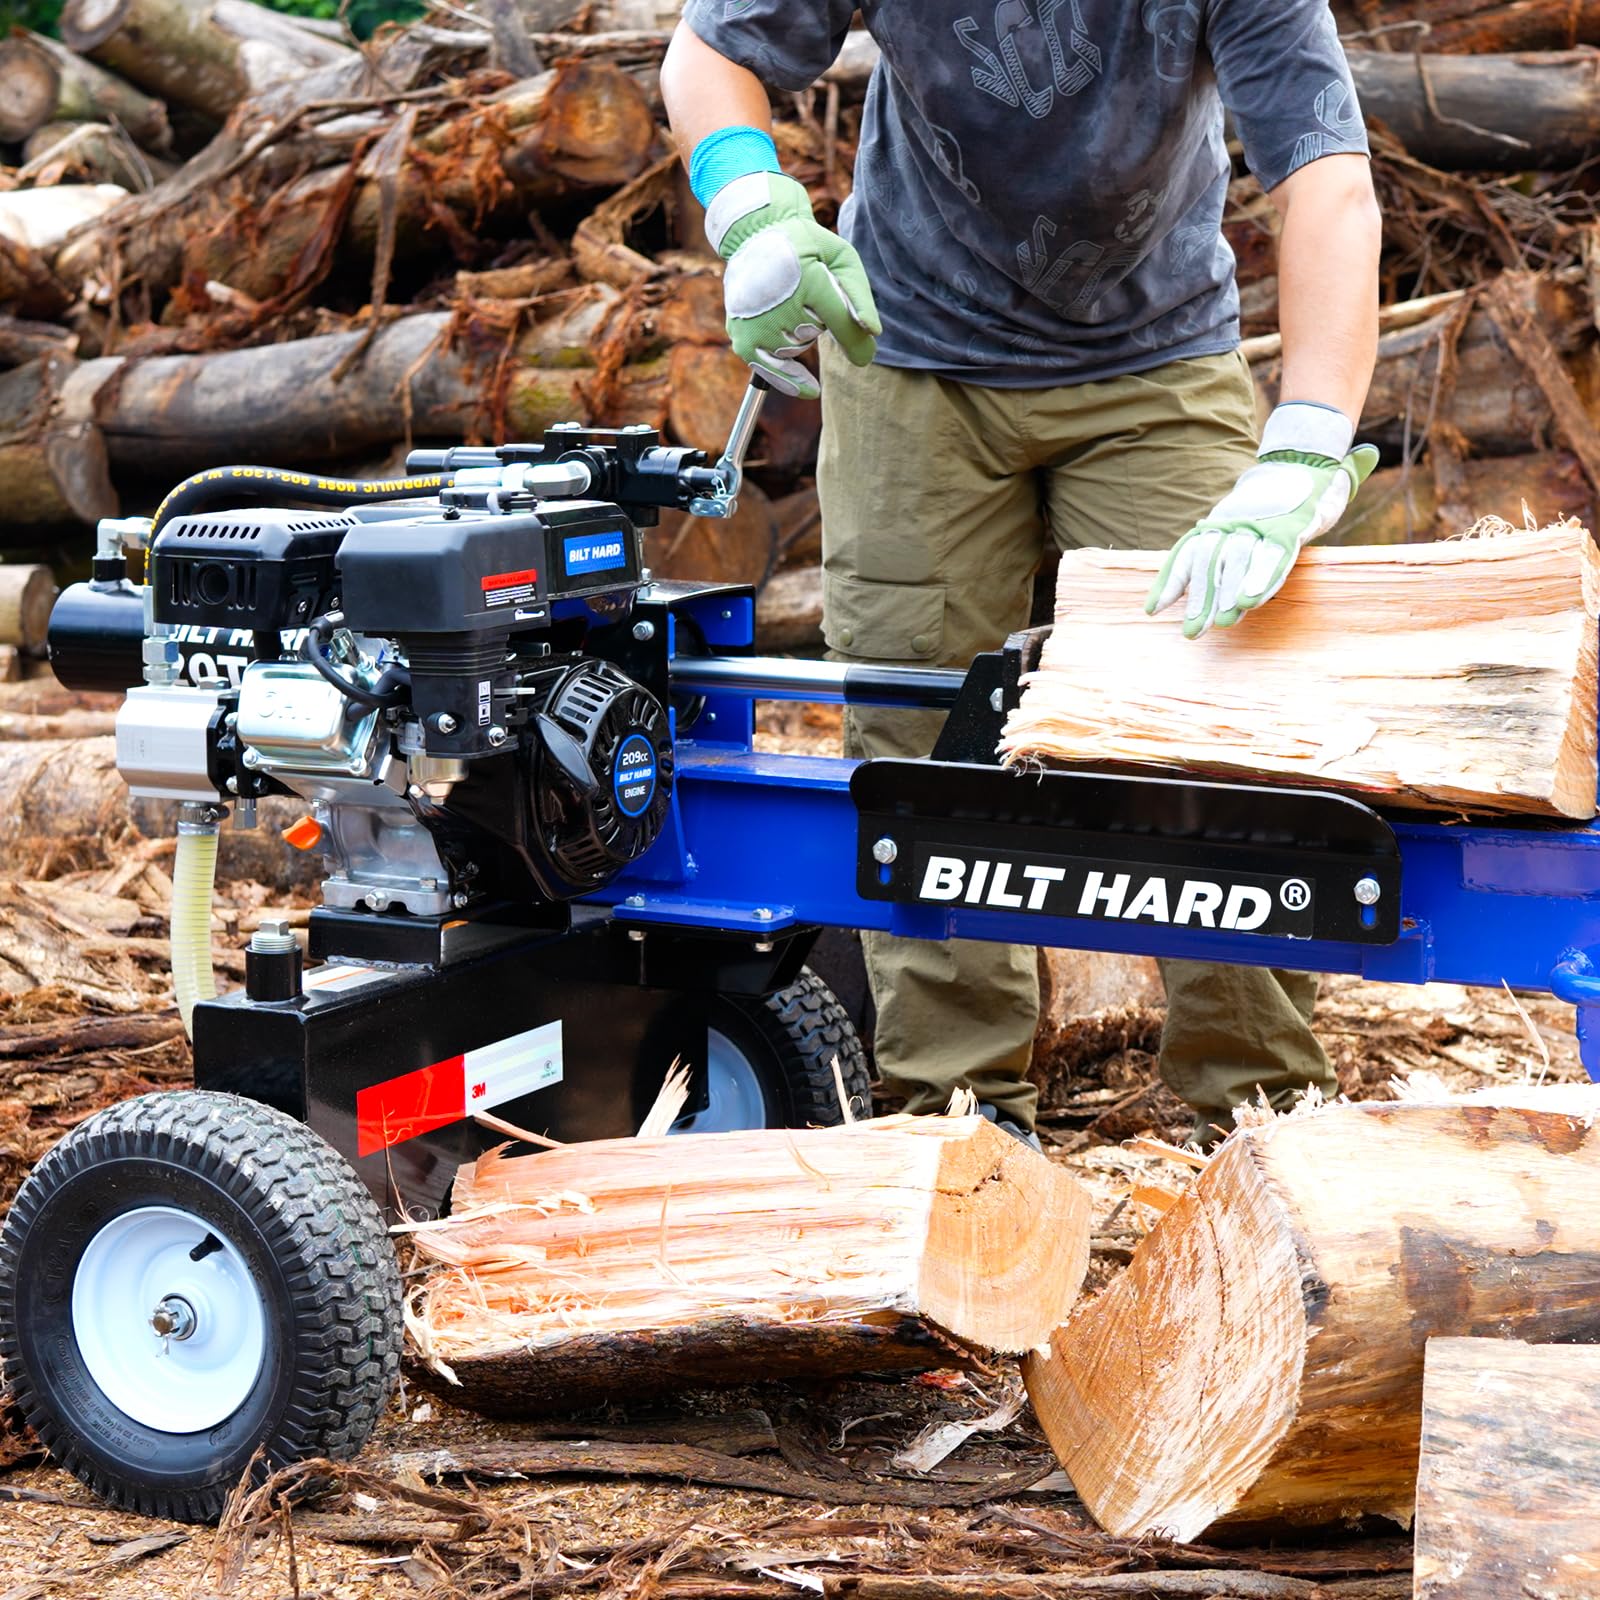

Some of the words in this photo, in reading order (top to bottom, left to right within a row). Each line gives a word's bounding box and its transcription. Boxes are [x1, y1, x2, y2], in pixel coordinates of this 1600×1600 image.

[317, 478, 357, 493] HOSE
[363, 475, 441, 493] HYDRAULIC
[569, 547, 590, 563] BILT
[591, 543, 621, 559] HARD
[622, 750, 649, 766] 209cc
[624, 785, 646, 799] ENGINE
[919, 855, 1066, 910] BILT
[471, 1081, 486, 1099] 3M
